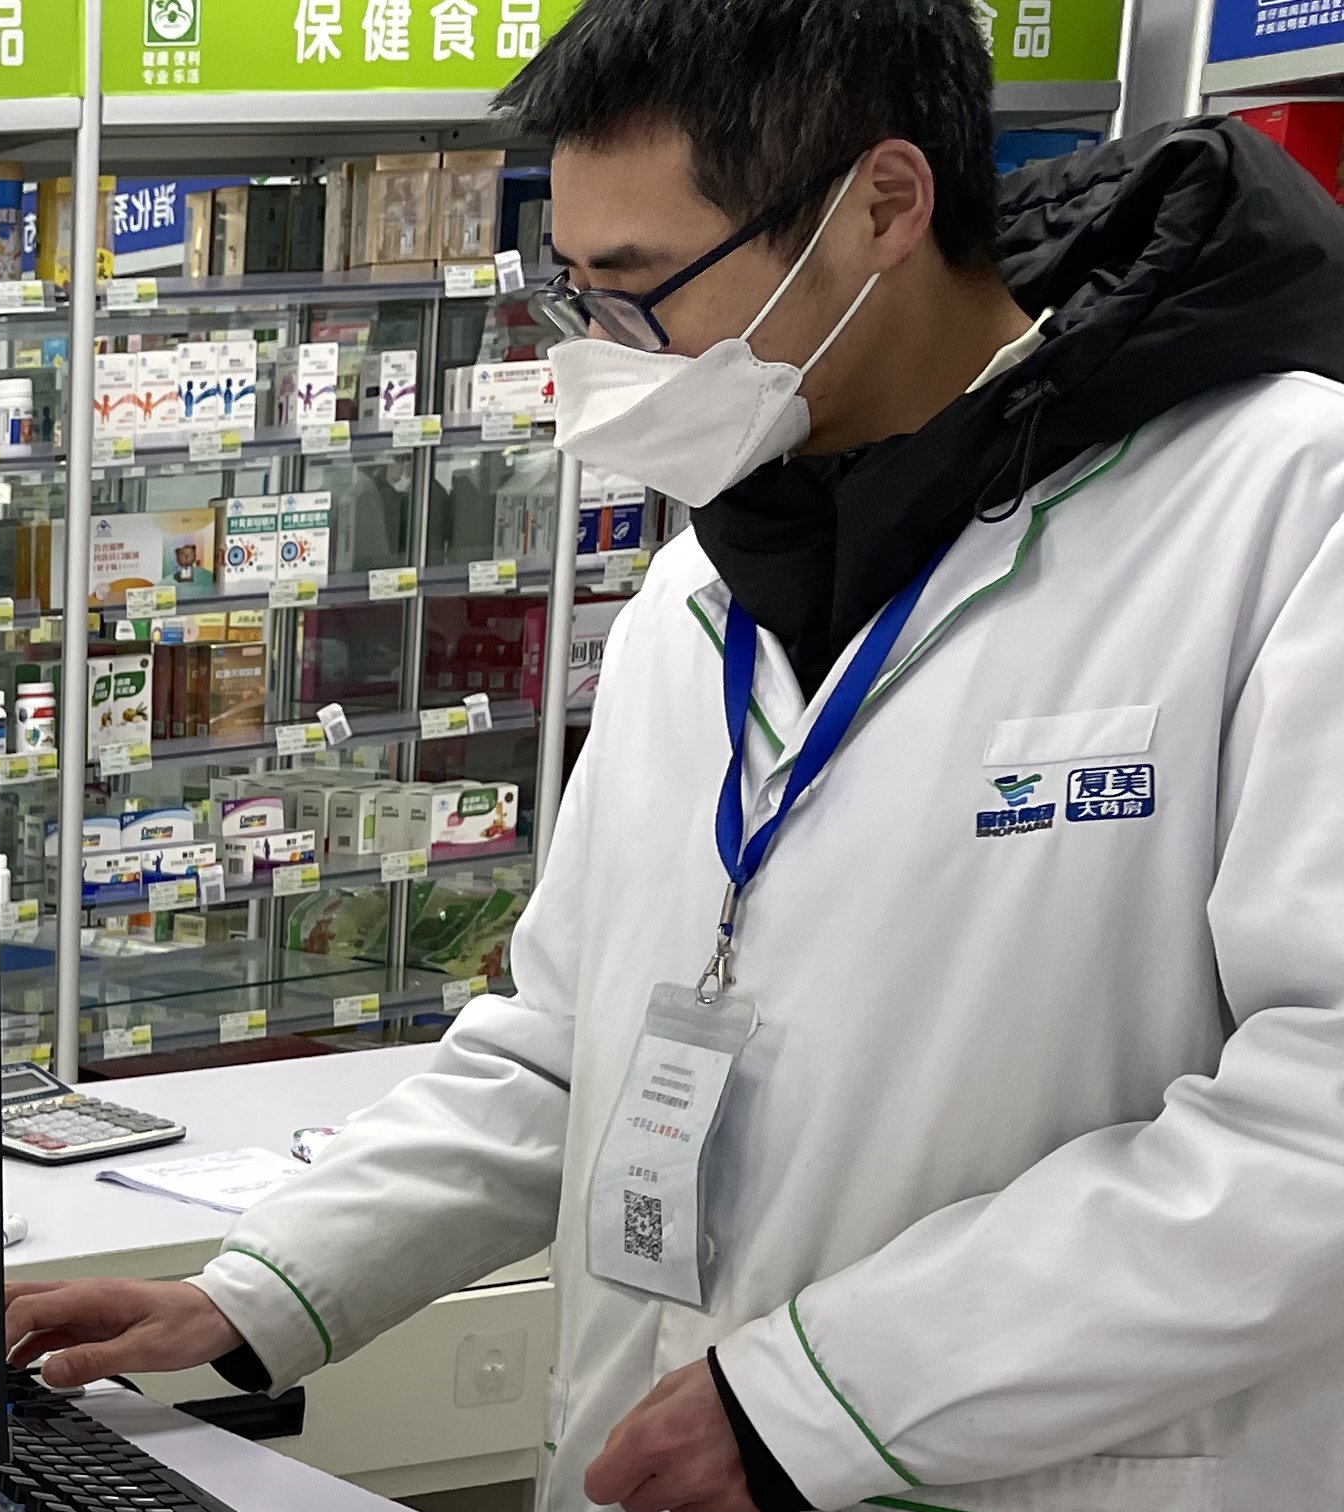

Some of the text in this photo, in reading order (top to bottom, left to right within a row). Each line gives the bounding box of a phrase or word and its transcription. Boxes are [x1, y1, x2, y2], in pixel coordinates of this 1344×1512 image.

[293, 0, 542, 65] 保健食品
[1075, 767, 1148, 798] 复美
[1077, 801, 1143, 817] 大药房
[239, 813, 268, 829] Centrum
[141, 825, 174, 841] Centrum
